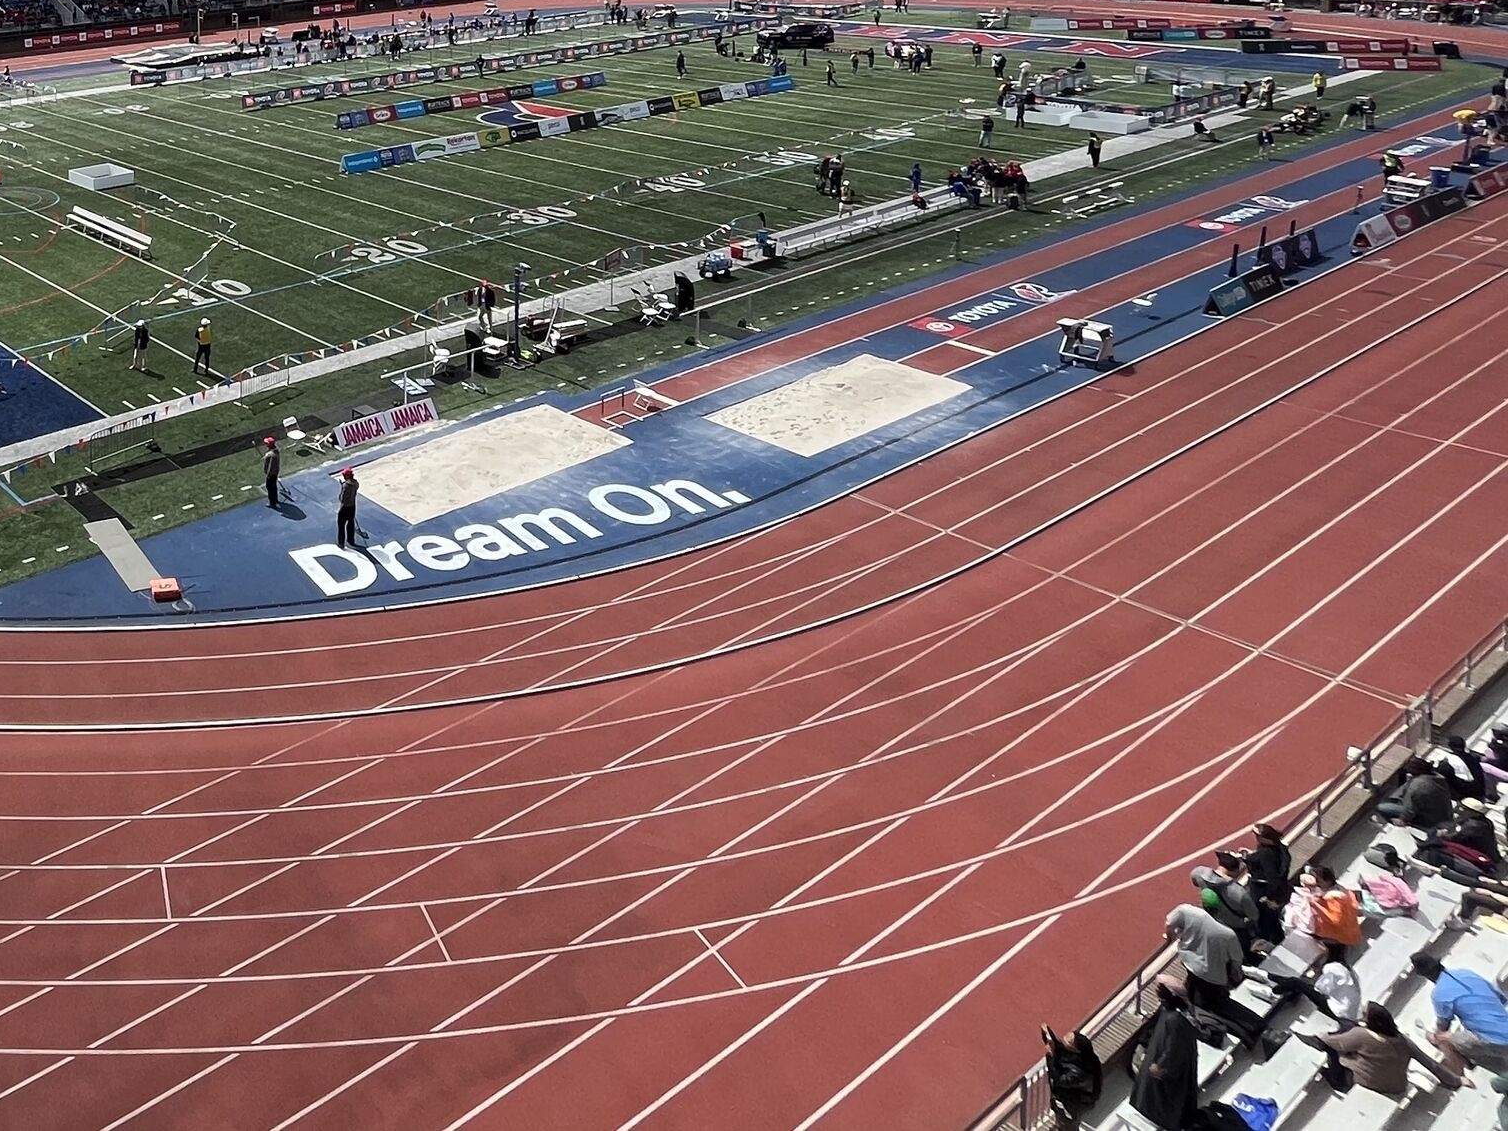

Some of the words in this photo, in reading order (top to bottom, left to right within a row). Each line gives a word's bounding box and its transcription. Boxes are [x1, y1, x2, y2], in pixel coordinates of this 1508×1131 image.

[302, 88, 320, 96] TOYOTA
[507, 206, 578, 224] 30
[350, 240, 429, 263] 20
[173, 278, 252, 306] 10
[1249, 274, 1276, 292] TIMEX
[947, 300, 1018, 323] TOYOTA
[390, 402, 434, 431] JAMAICA
[341, 417, 385, 447] JAMAICA
[288, 506, 604, 597] Dream
[588, 479, 753, 526] On.
